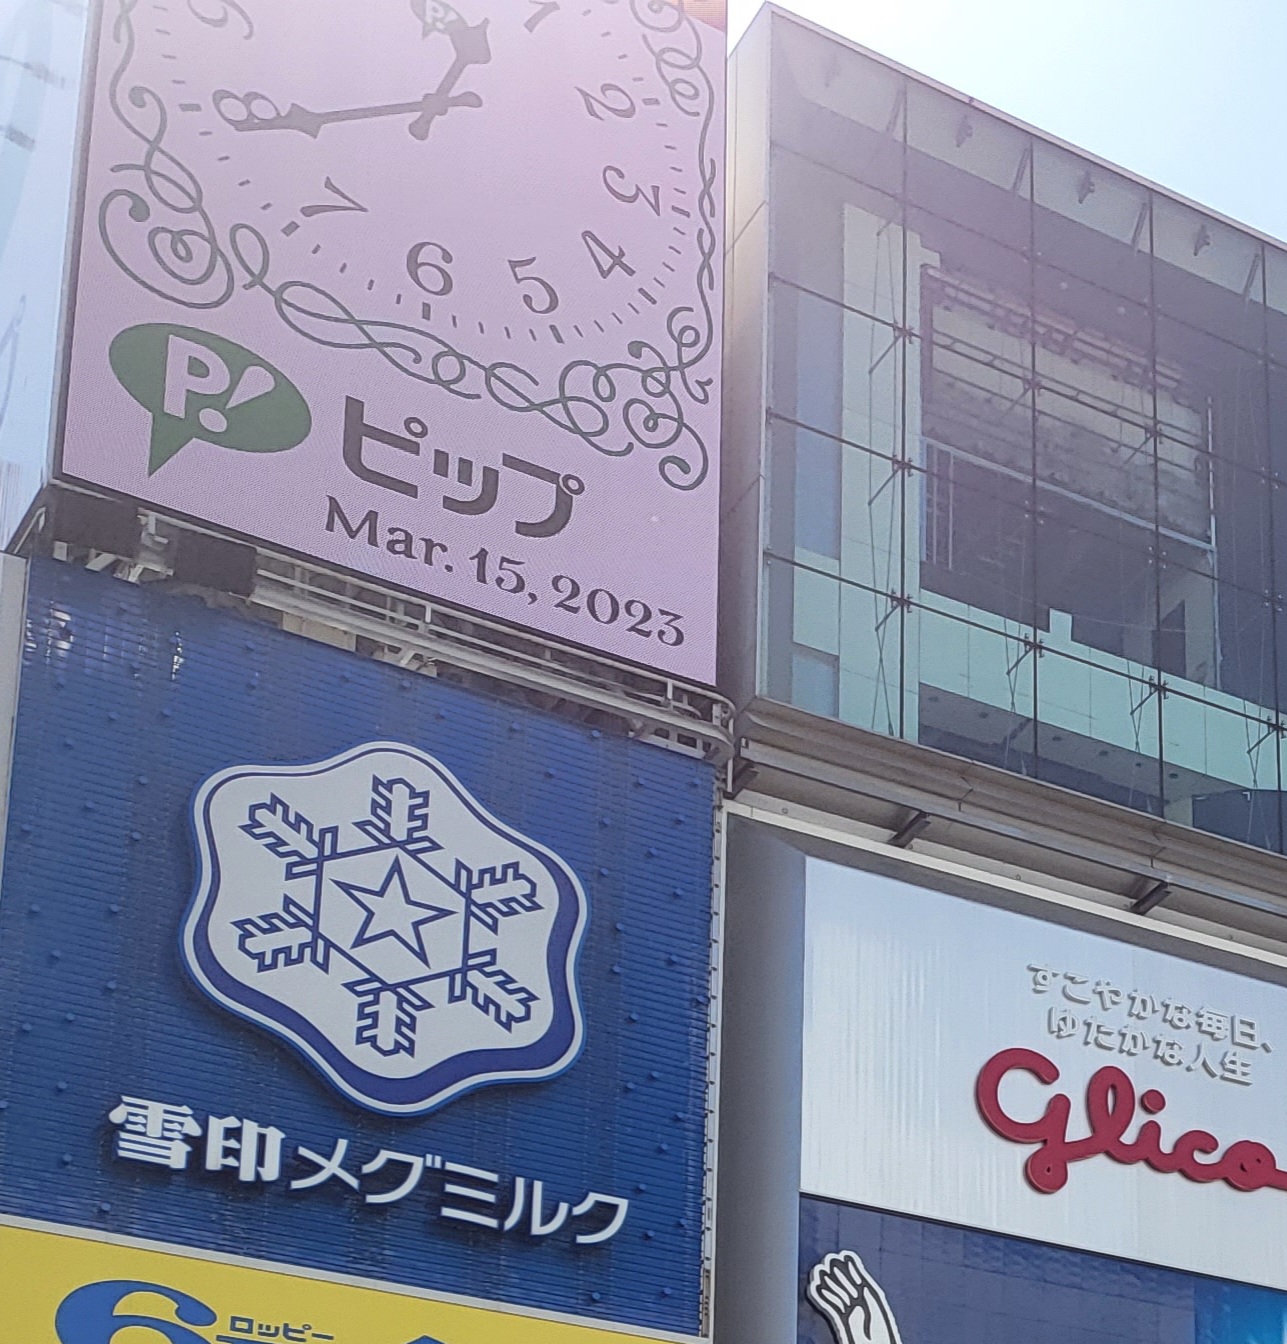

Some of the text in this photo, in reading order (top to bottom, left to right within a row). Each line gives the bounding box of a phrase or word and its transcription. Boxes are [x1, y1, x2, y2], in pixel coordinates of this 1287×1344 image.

[577, 83, 637, 121] 2
[300, 176, 368, 214] 7
[601, 165, 661, 216] 3
[405, 240, 455, 297] 6
[581, 228, 637, 281] 4
[508, 256, 560, 315] 5
[342, 394, 586, 540] ピップ
[324, 495, 455, 574] Mar.
[551, 573, 687, 648] 2023
[1026, 962, 1276, 1054] すこやかな毎日、
[1047, 1006, 1254, 1086] ゆたかな人生
[107, 1092, 630, 1245] 雪印メグミルク
[229, 1314, 335, 1344] ロッピー
